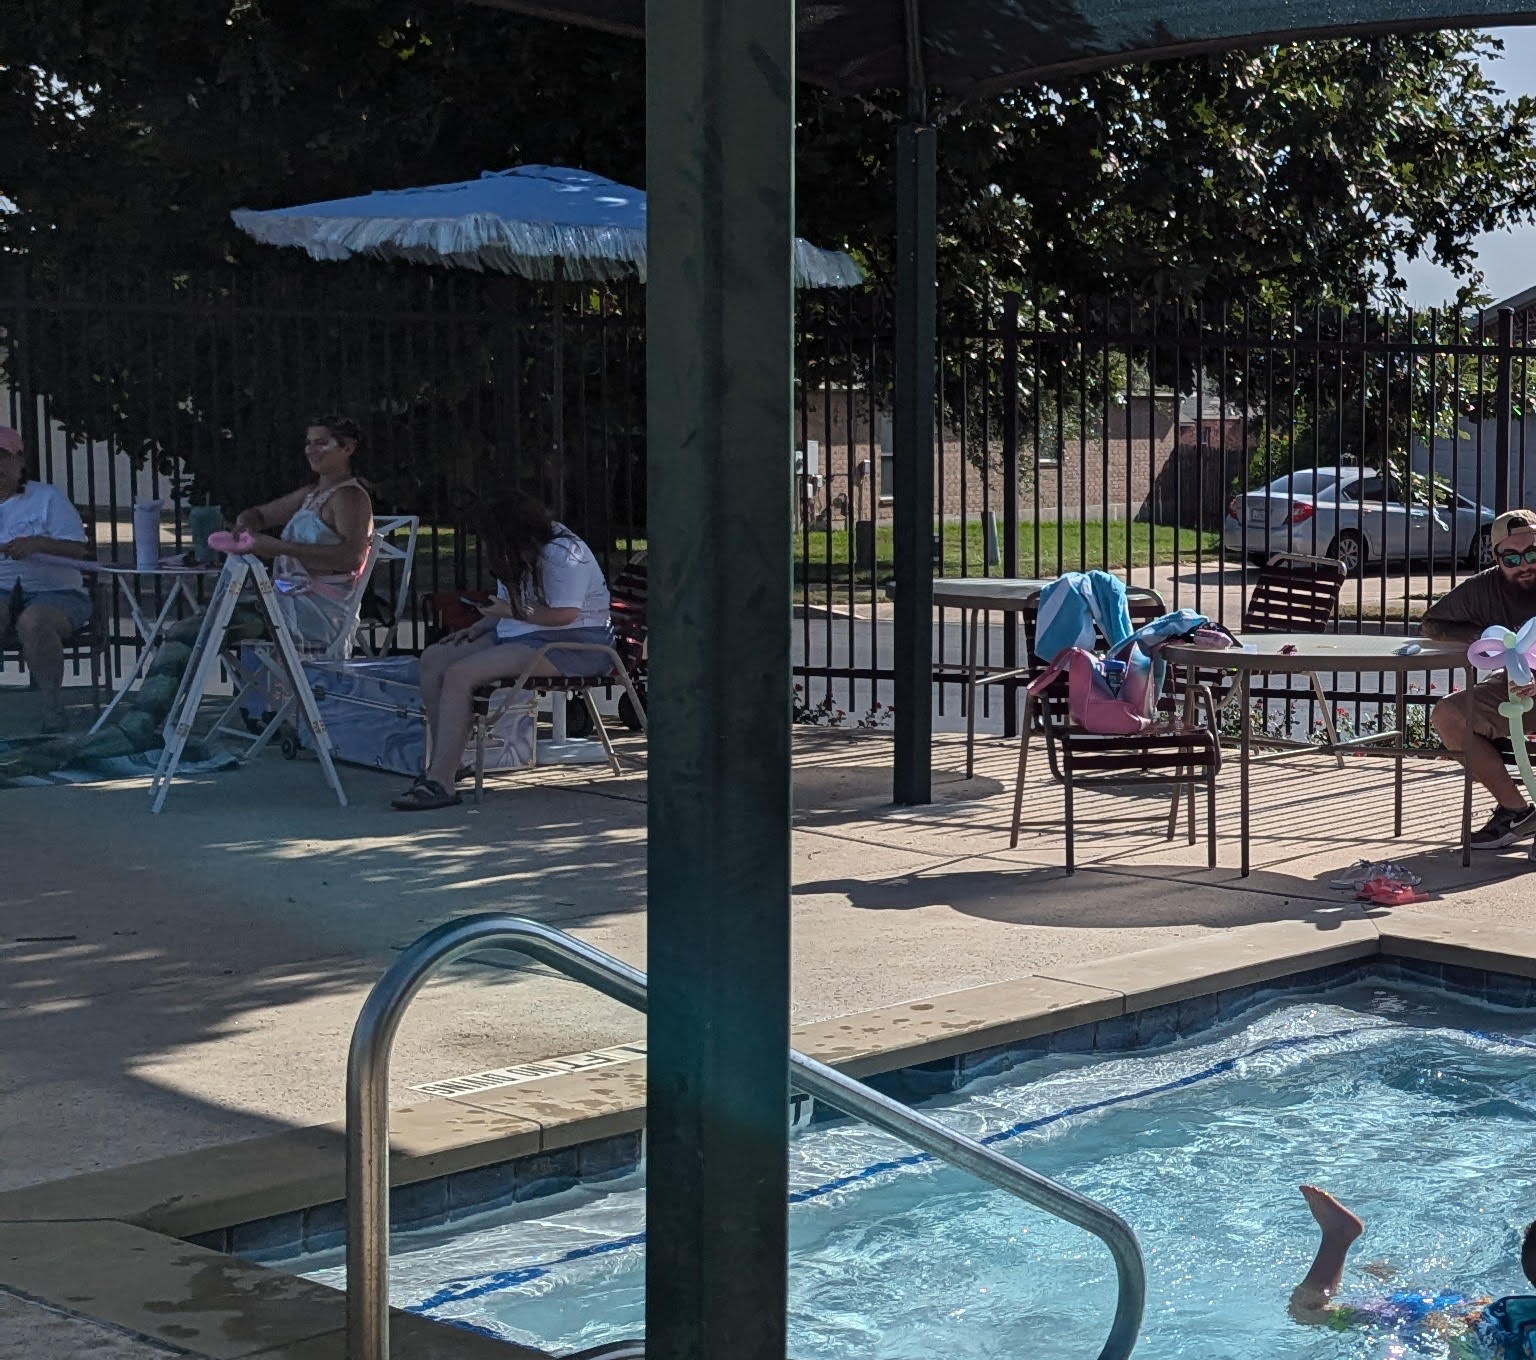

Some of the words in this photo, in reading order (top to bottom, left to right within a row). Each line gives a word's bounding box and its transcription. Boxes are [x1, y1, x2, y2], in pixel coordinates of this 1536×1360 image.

[552, 1052, 620, 1070] FT
[505, 1064, 560, 1077] NO
[419, 1072, 521, 1095] DIVING
